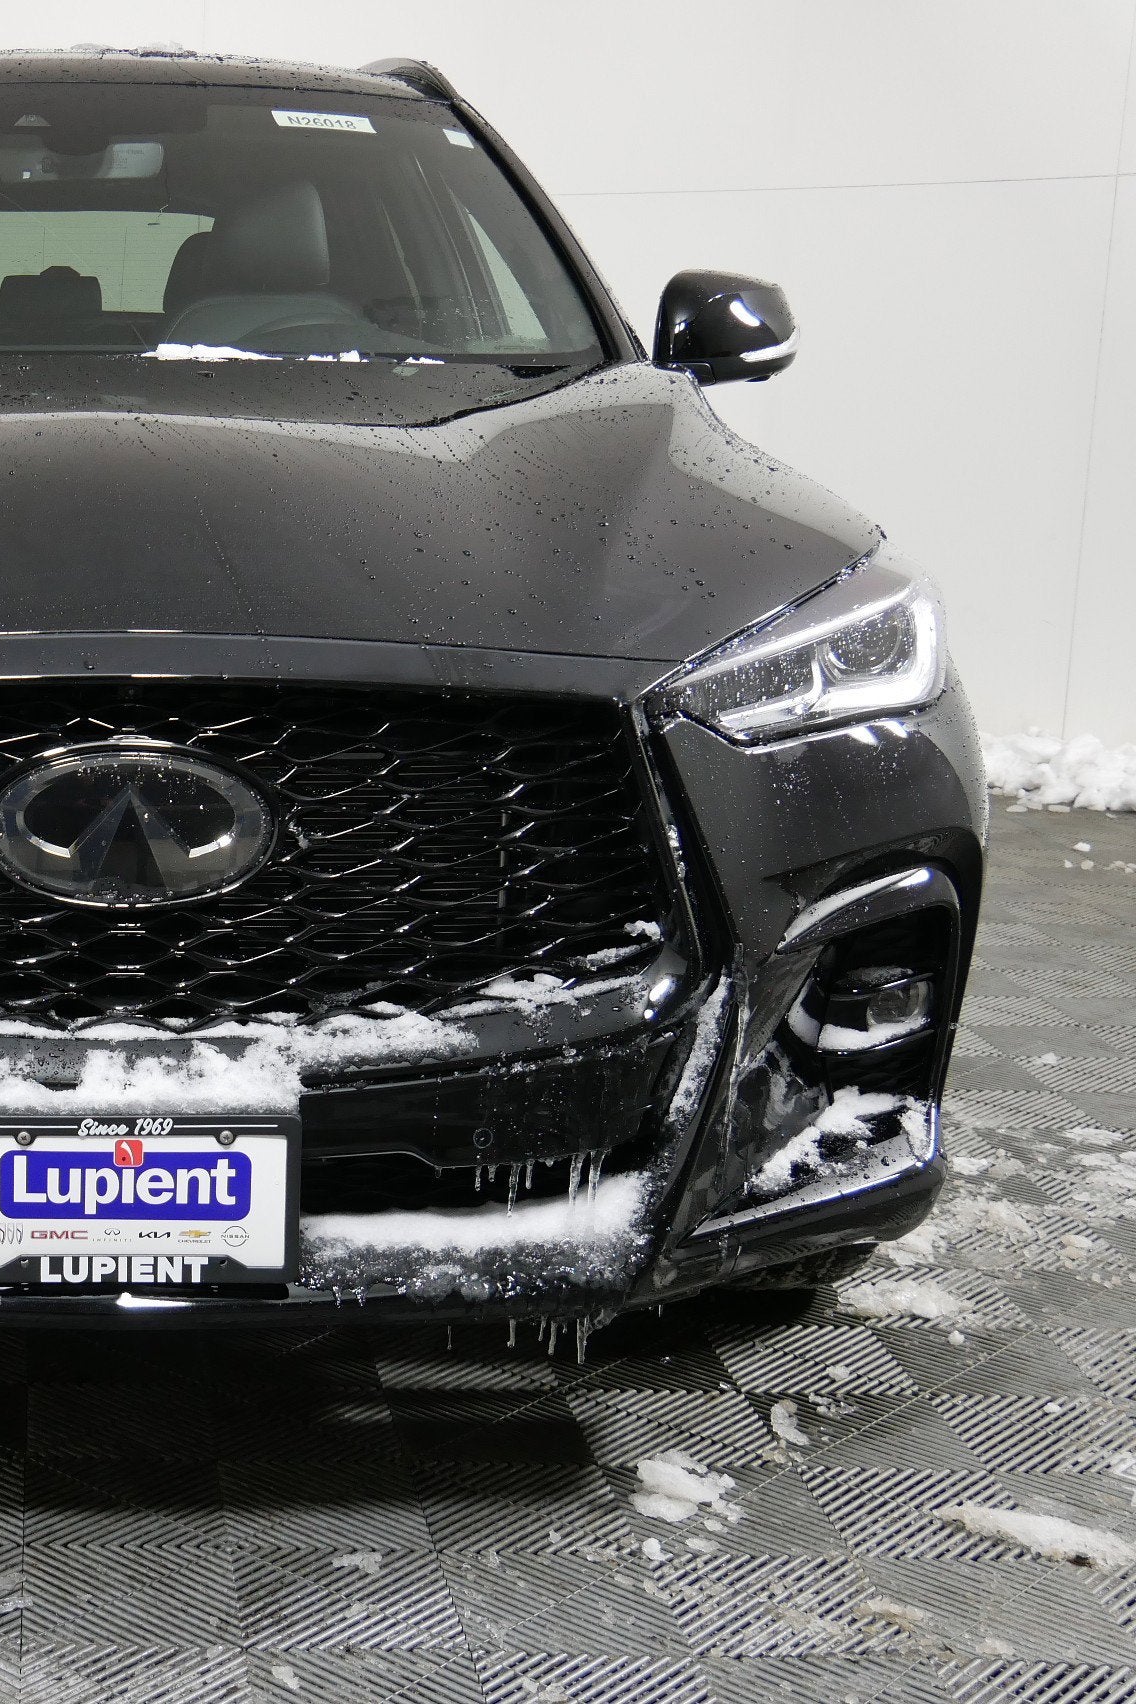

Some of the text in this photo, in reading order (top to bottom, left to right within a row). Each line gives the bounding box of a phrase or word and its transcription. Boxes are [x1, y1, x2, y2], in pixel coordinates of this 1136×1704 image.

[286, 115, 357, 130] N26018
[77, 1117, 174, 1137] Since 1969
[13, 1155, 237, 1215] Lupient
[31, 1230, 89, 1240] GMC
[40, 1256, 209, 1283] LUPIENT
